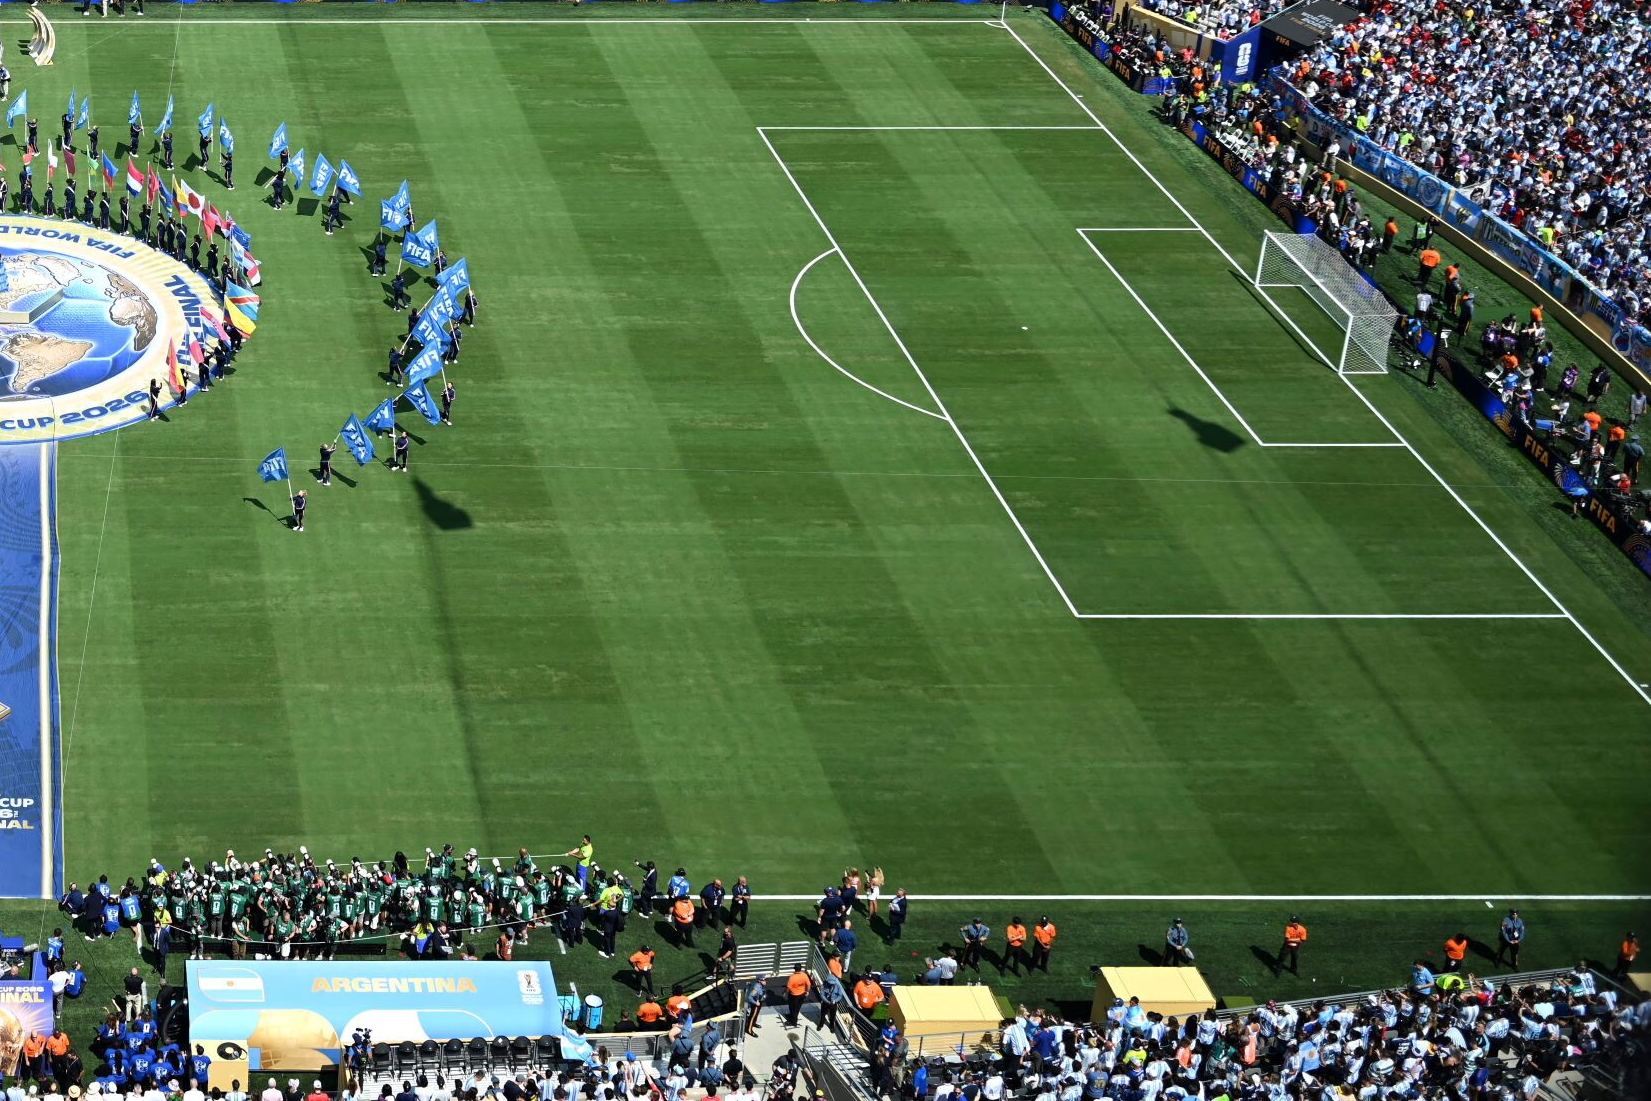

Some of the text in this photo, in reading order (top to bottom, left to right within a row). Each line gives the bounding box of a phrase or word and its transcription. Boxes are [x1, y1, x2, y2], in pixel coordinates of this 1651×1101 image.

[1078, 28, 1093, 48] FIFA
[1276, 35, 1291, 47] FIFA
[1115, 59, 1130, 80] FIFA
[1203, 134, 1221, 157] FIFA
[1248, 175, 1267, 199] FIFA
[85, 238, 134, 259] FIFA
[407, 241, 431, 261] FIFA
[60, 389, 151, 425] 2026
[1524, 434, 1549, 467] FIFA
[1589, 499, 1617, 533] FIFA
[0, 798, 35, 808] CUP
[312, 976, 477, 993] ARGENTINA
